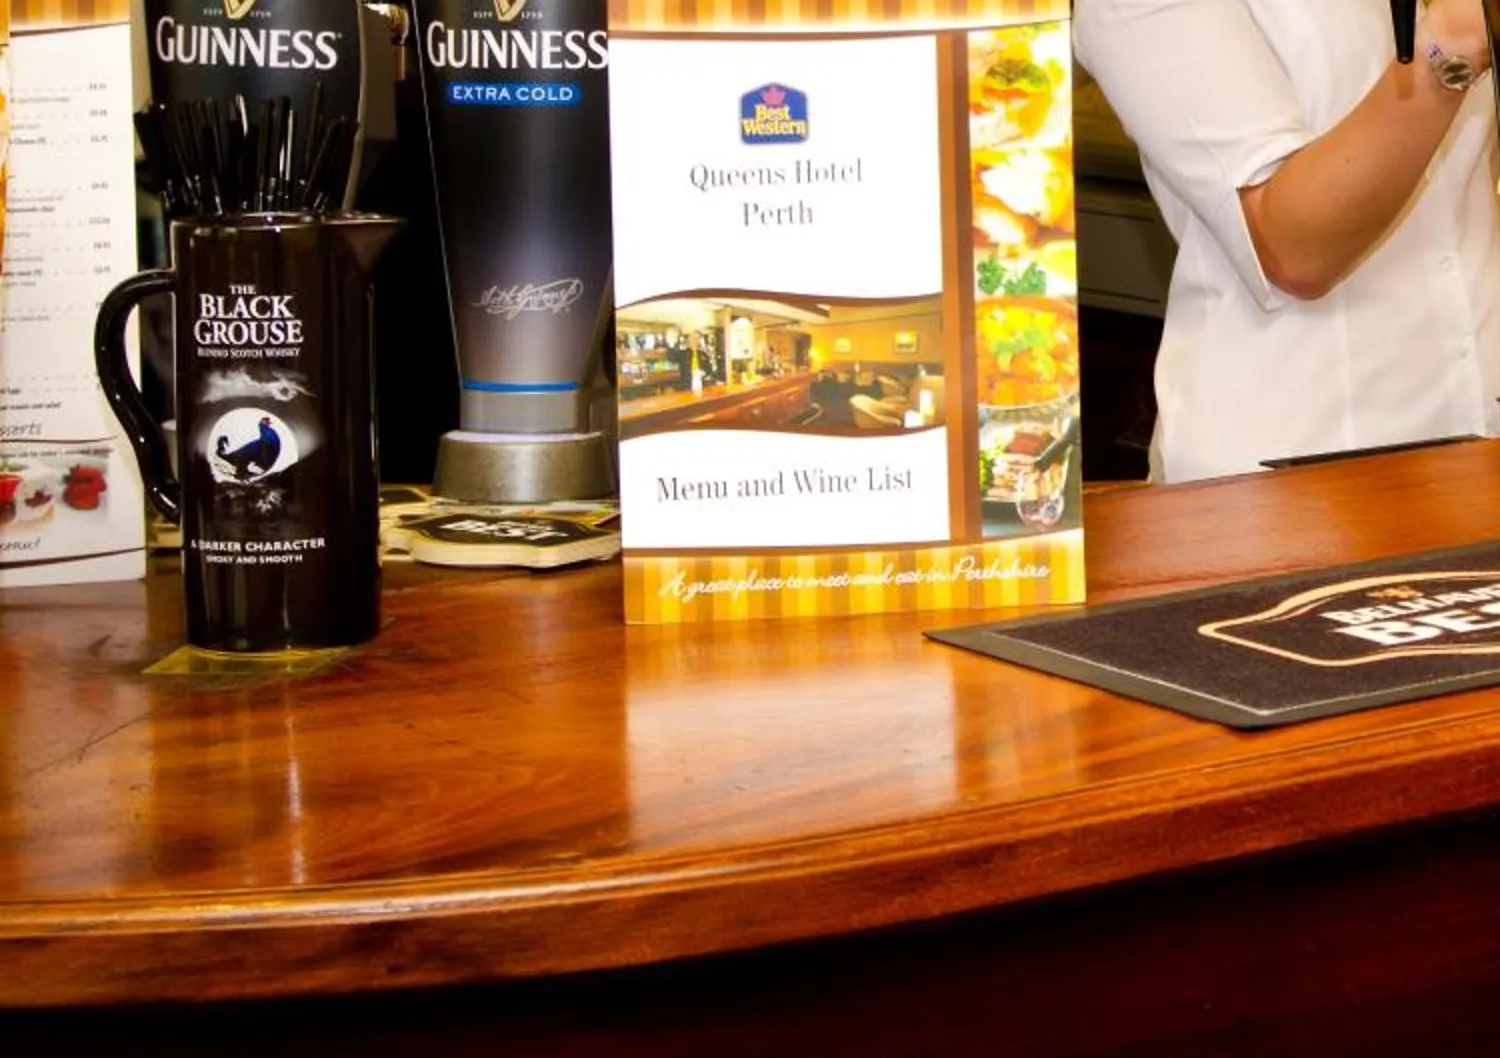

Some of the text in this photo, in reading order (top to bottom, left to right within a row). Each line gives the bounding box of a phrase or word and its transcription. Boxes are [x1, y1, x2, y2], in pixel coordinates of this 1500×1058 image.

[156, 15, 339, 71] GUINNESS
[427, 20, 609, 70] GUINNESS
[452, 85, 574, 102] EXTRA COLD
[755, 104, 791, 121] Best
[741, 118, 807, 135] Western
[689, 157, 863, 192] Queens Hotel
[741, 200, 814, 228] Perth
[228, 284, 257, 296] THE
[199, 292, 296, 319] BLACK
[193, 318, 305, 345] GROUSE
[657, 466, 914, 503] Menu and Wine List
[245, 537, 326, 552] CHARACTER
[236, 555, 257, 564] AND
[731, 569, 783, 603] place
[850, 564, 894, 586] and
